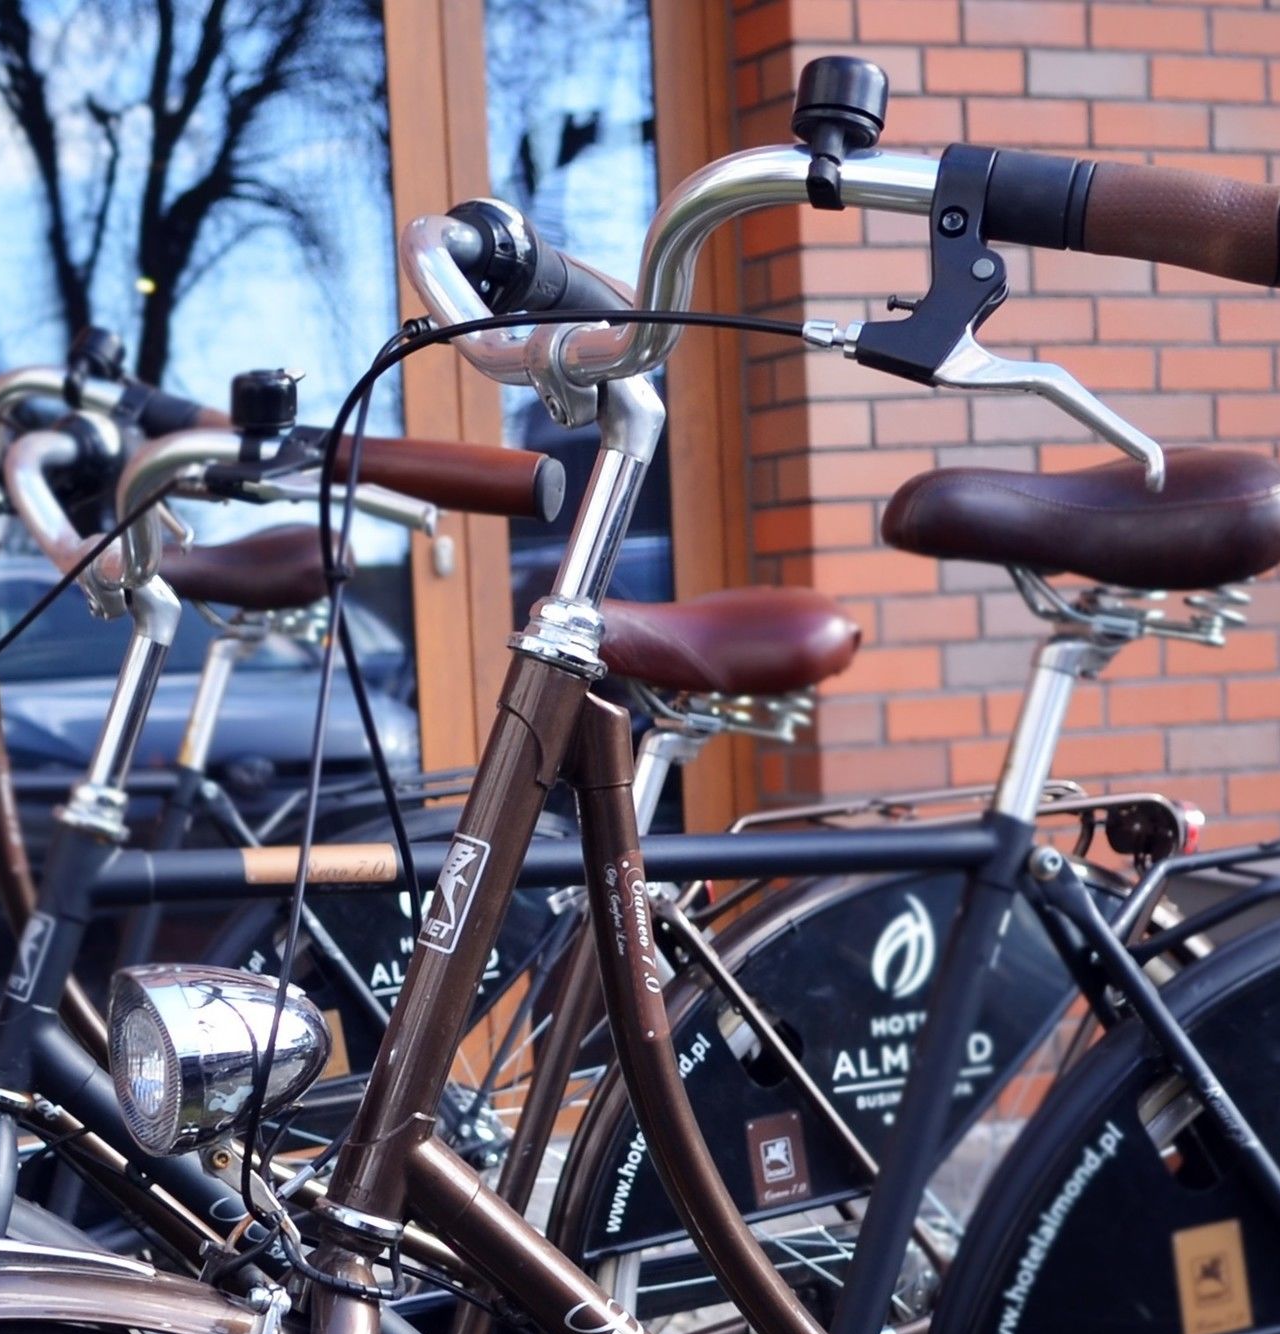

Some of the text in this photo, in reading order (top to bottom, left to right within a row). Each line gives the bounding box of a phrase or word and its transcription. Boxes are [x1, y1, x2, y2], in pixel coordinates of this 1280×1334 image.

[641, 955, 661, 994] 7.0
[871, 1011, 928, 1038] HOT
[832, 1032, 993, 1081] ALMD
